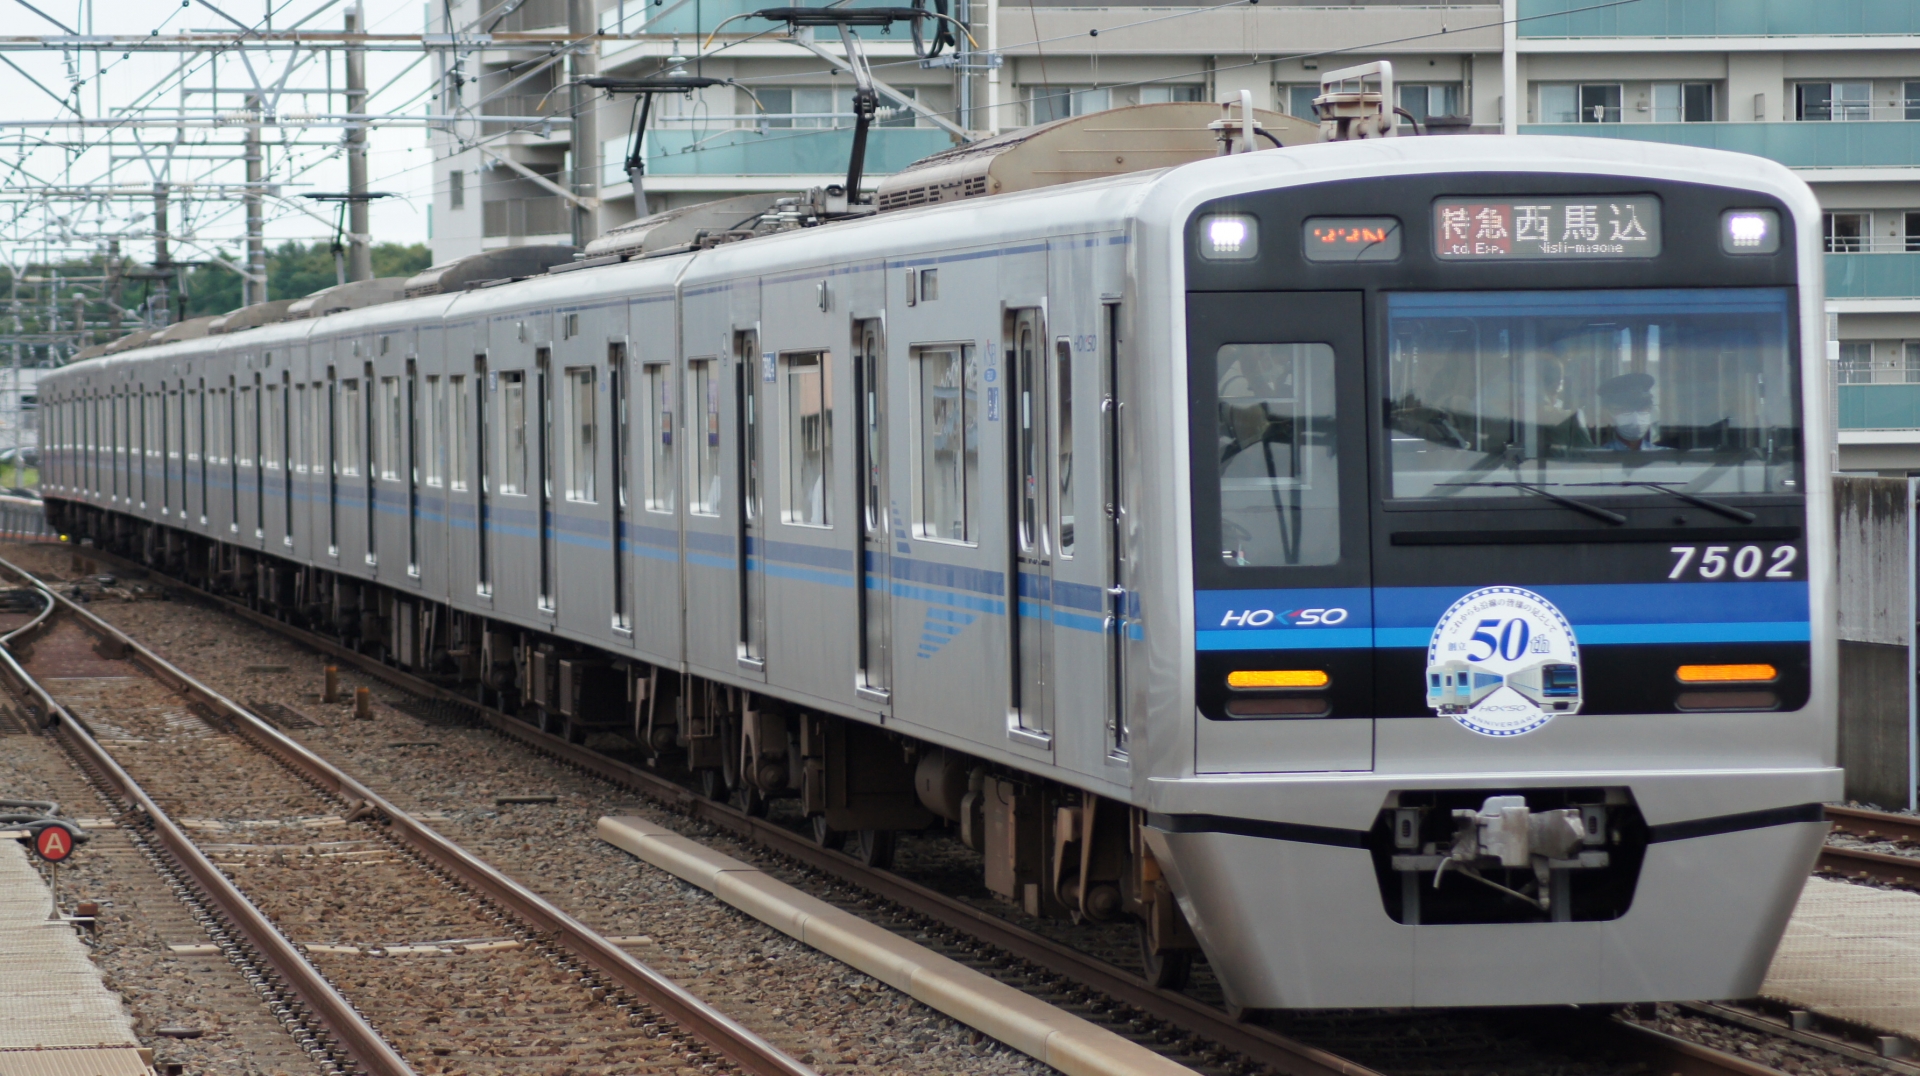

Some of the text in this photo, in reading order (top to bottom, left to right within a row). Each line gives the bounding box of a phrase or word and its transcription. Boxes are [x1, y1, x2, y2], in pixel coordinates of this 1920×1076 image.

[1442, 203, 1648, 241] 特急 西馬込
[1667, 545, 1798, 579] 7502
[1470, 712, 1539, 728] ANNIVERSARY
[43, 832, 65, 854] A
